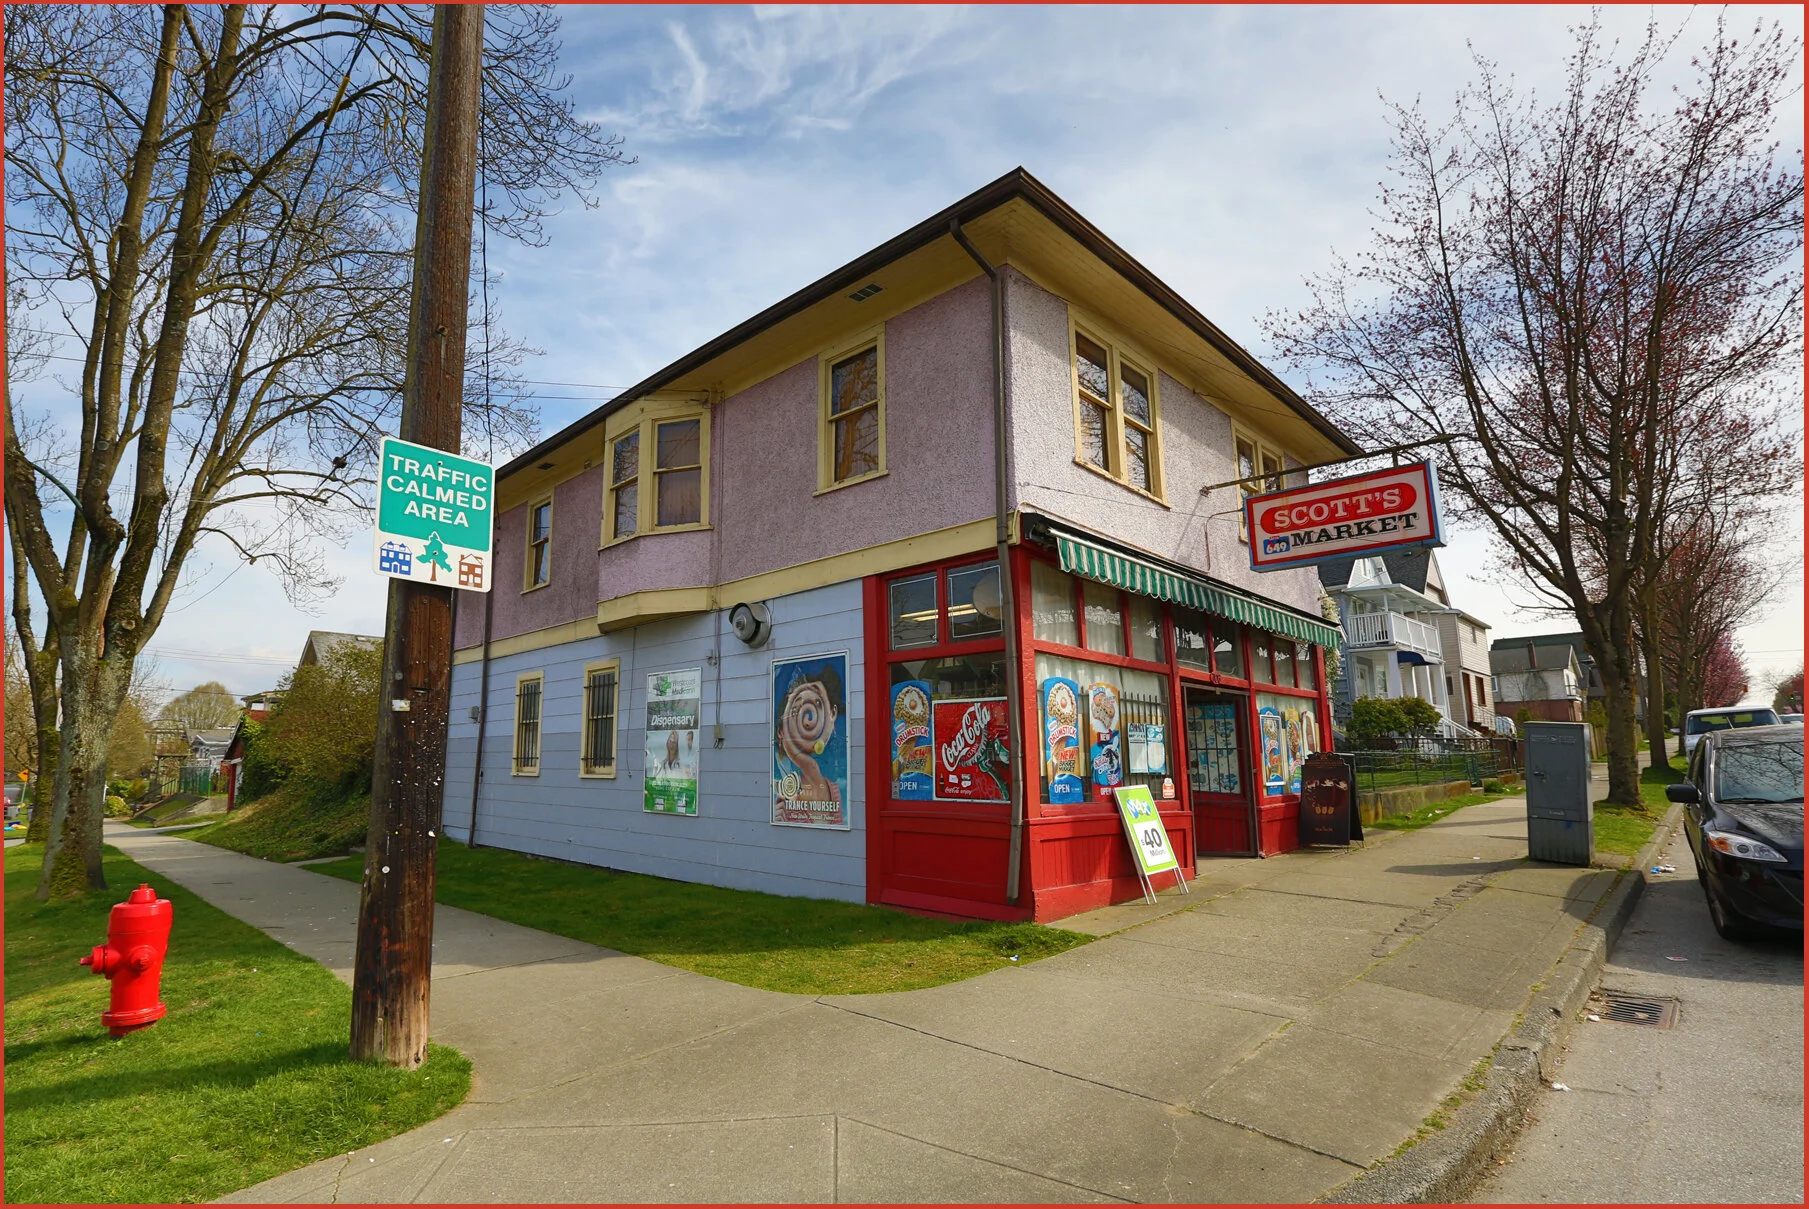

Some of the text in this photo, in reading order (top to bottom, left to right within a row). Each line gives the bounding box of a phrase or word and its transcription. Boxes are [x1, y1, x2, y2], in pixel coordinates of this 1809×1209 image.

[388, 454, 487, 492] TRAFFIC
[387, 475, 487, 511] CALMED
[404, 500, 469, 528] AREA
[1274, 488, 1401, 528] SCOTT'S
[1291, 512, 1418, 547] MARKET
[651, 714, 694, 727] Dispensary
[895, 725, 929, 747] DRUMSTICK
[1049, 726, 1076, 745] DRUMSTICK
[1054, 784, 1070, 793] OPEN
[785, 800, 840, 812] TRANCE YOURSELF
